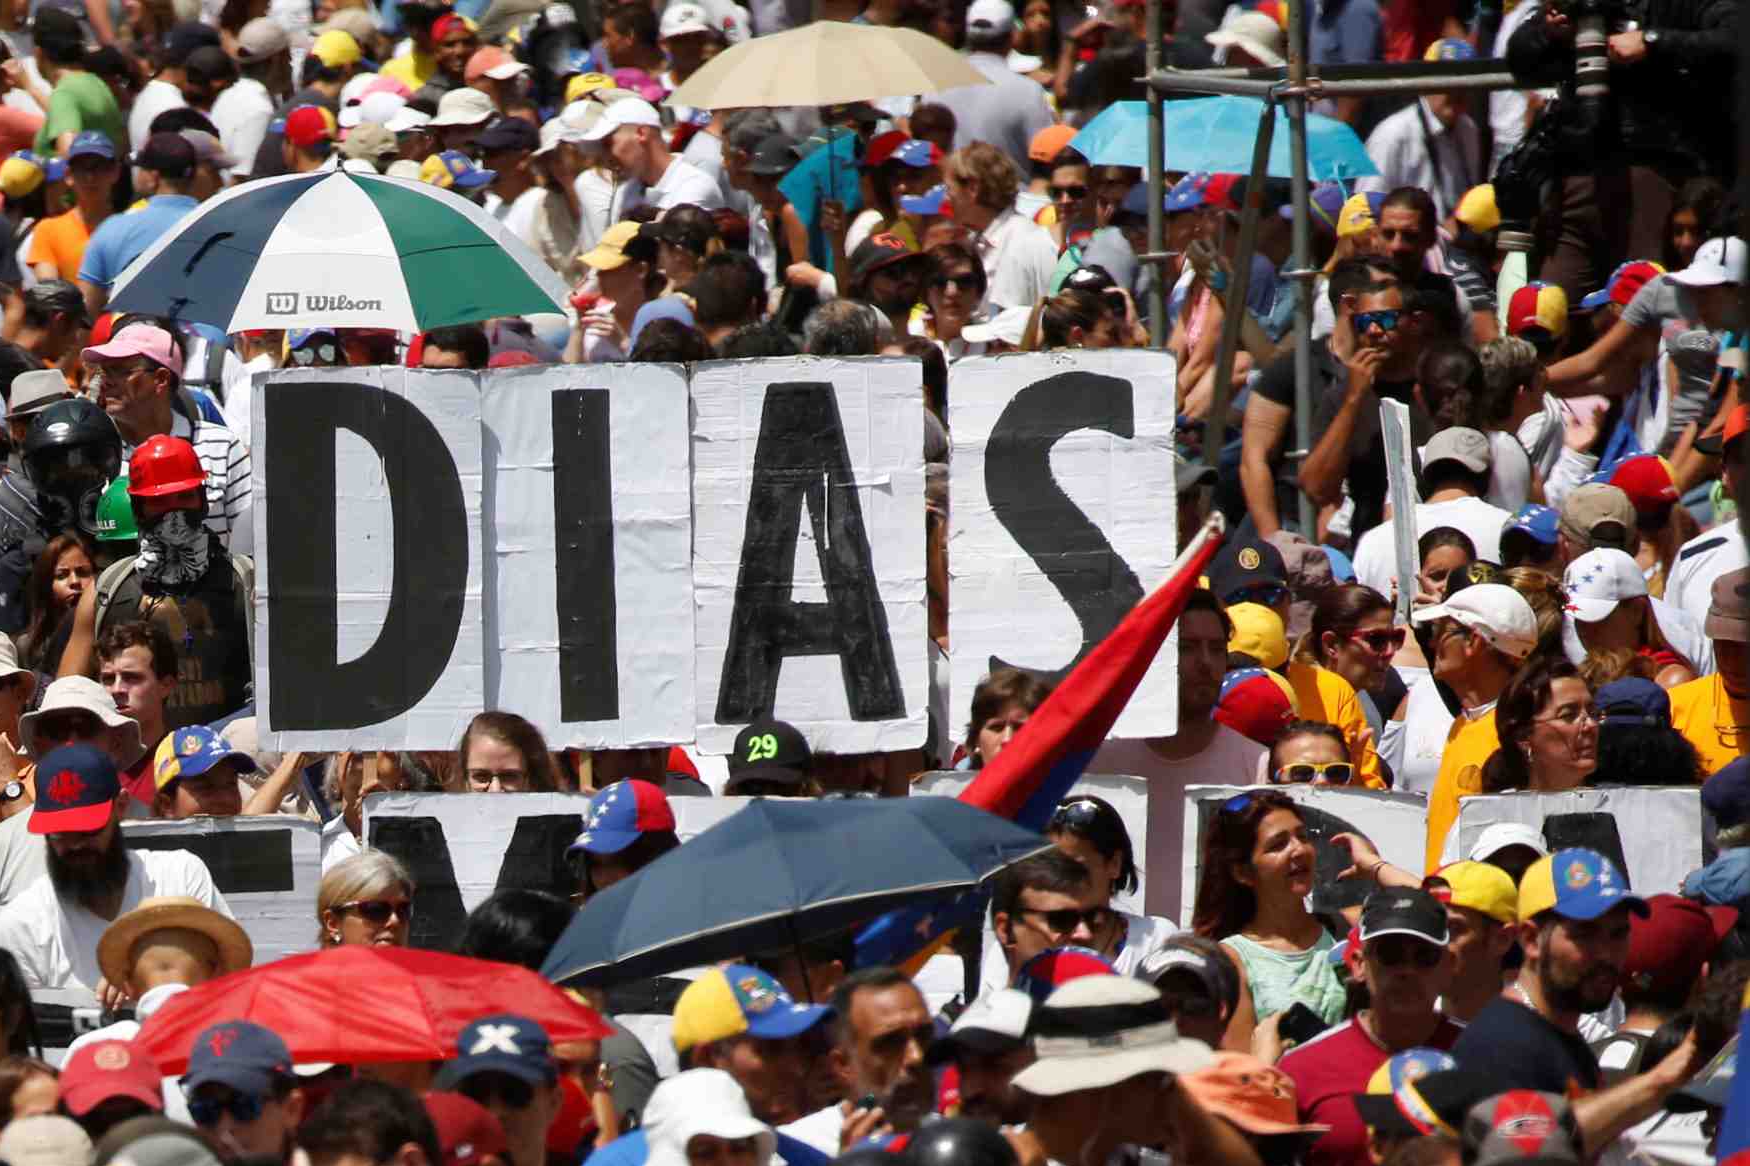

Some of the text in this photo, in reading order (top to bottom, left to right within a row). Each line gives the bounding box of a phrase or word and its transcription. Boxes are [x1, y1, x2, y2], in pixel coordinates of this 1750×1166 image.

[306, 294, 382, 312] Wilson
[265, 371, 1150, 735] DIAS
[747, 733, 778, 762] 29
